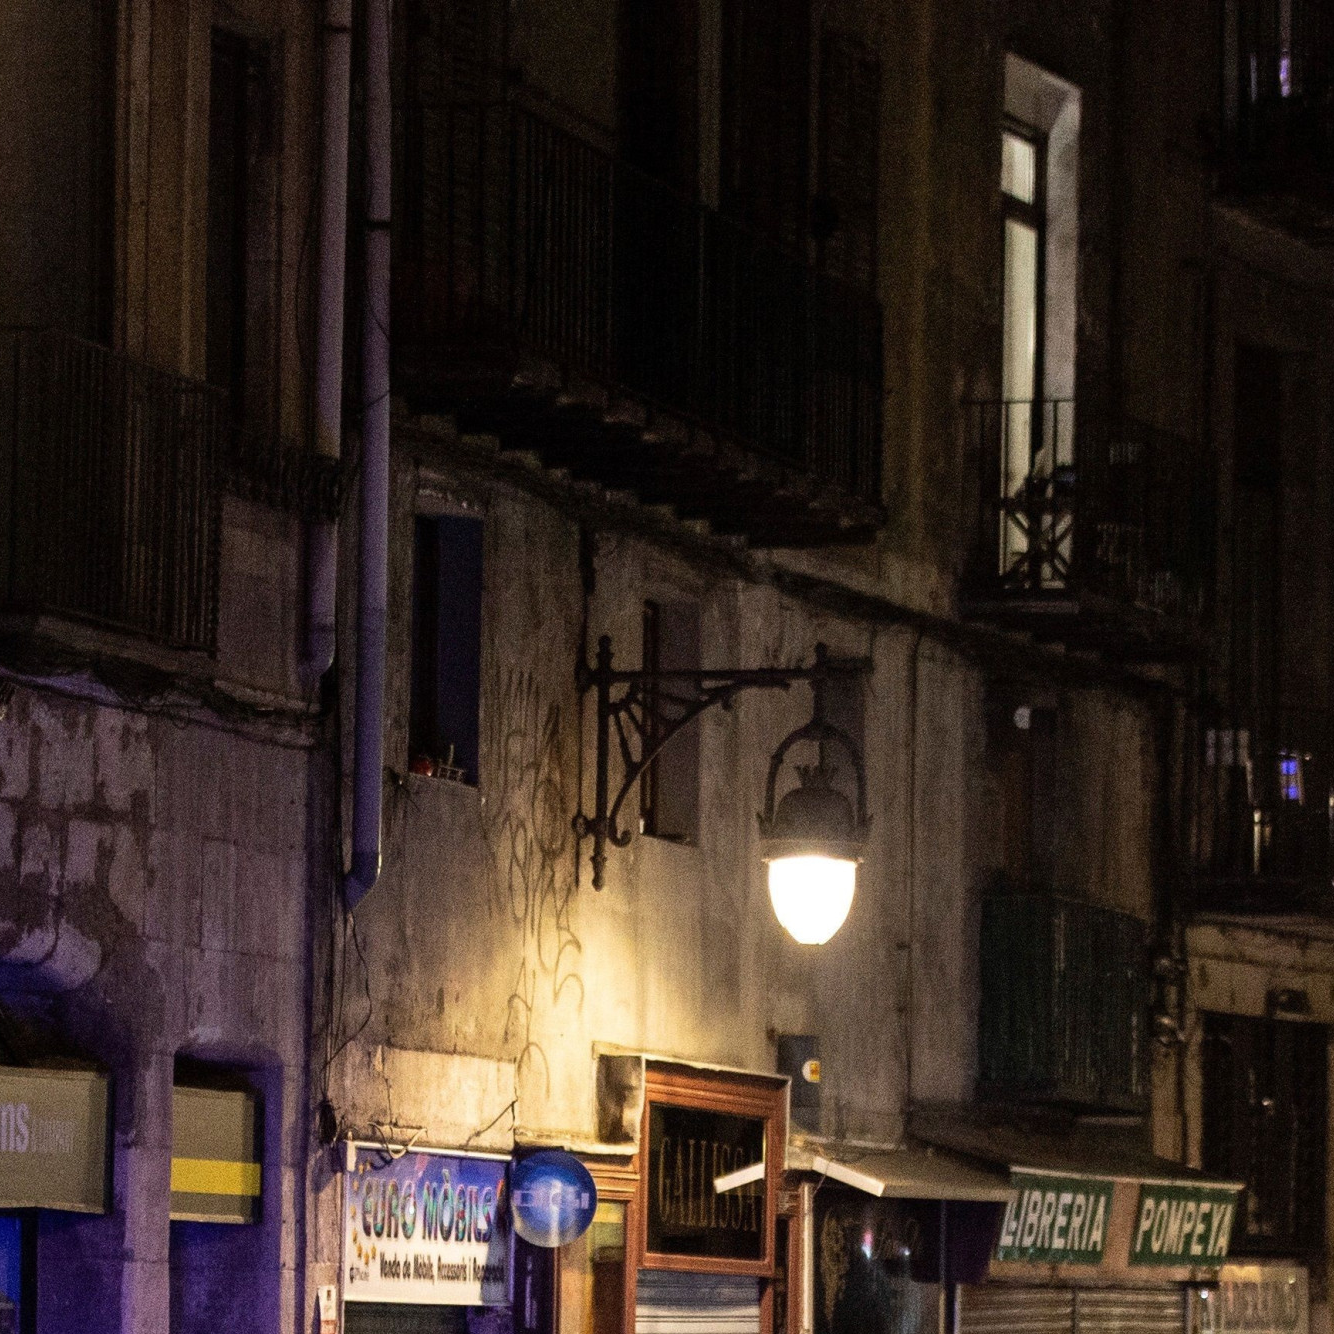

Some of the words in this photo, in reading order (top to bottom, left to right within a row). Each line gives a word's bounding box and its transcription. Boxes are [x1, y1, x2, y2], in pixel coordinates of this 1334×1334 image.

[1134, 1198, 1234, 1256] POMPEYA
[380, 1252, 401, 1280] Venda
[403, 1253, 411, 1280] de
